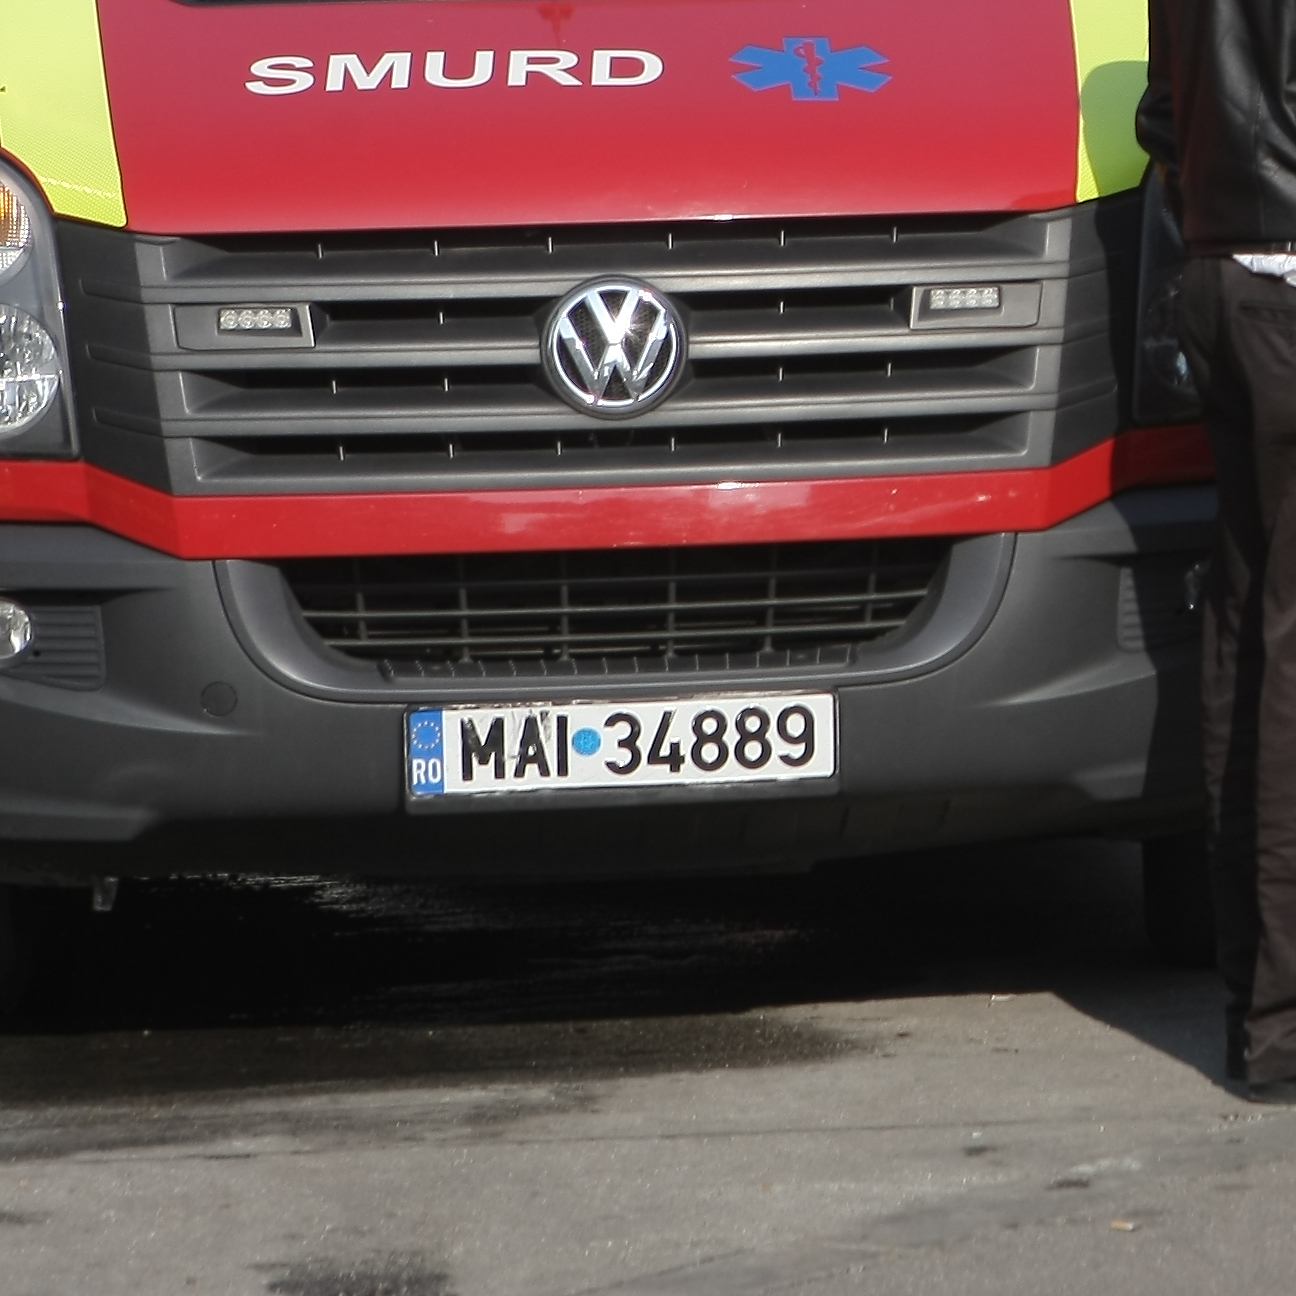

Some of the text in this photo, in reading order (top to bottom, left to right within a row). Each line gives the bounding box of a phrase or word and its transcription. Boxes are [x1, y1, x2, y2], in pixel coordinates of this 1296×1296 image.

[244, 48, 665, 96] SMURD
[460, 705, 816, 782] MAI 34889
[412, 758, 442, 786] RO
